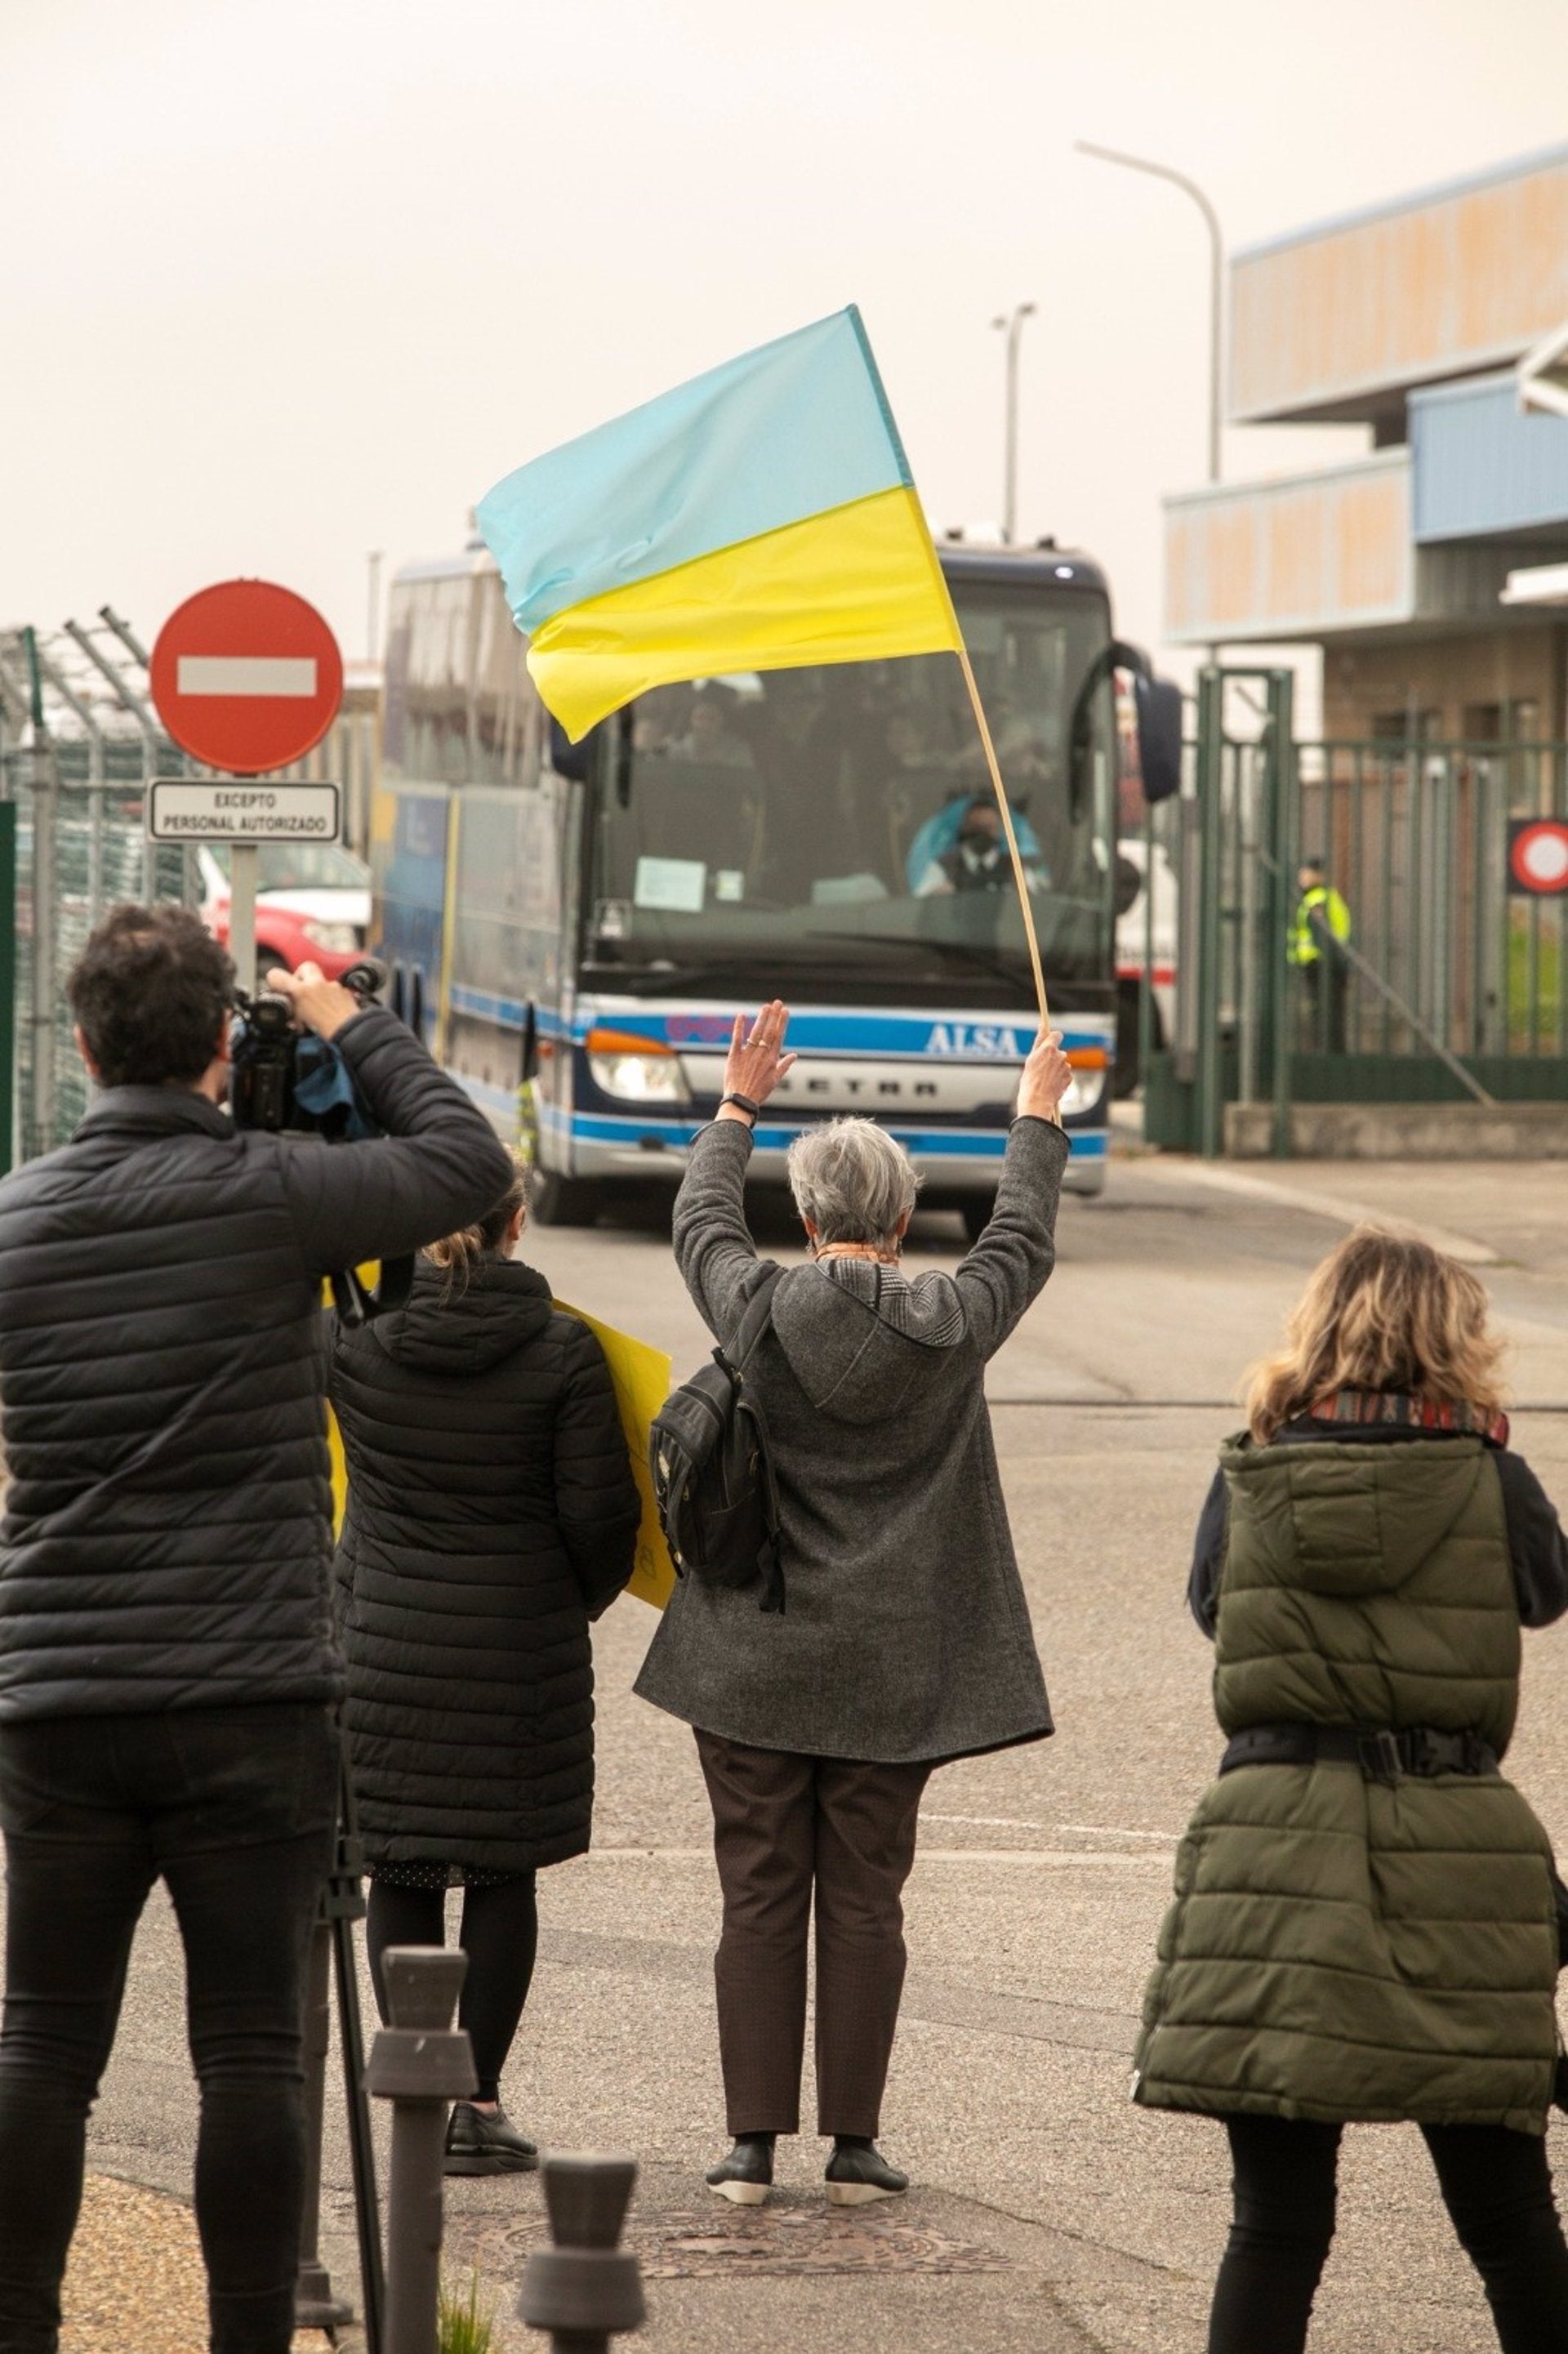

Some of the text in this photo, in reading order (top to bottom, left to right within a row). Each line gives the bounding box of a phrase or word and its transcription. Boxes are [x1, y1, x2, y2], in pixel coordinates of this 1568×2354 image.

[213, 792, 276, 808] EXCEPTO
[164, 815, 327, 831] PERSONAL AUTORIZADO
[925, 1023, 1019, 1058] ALSA
